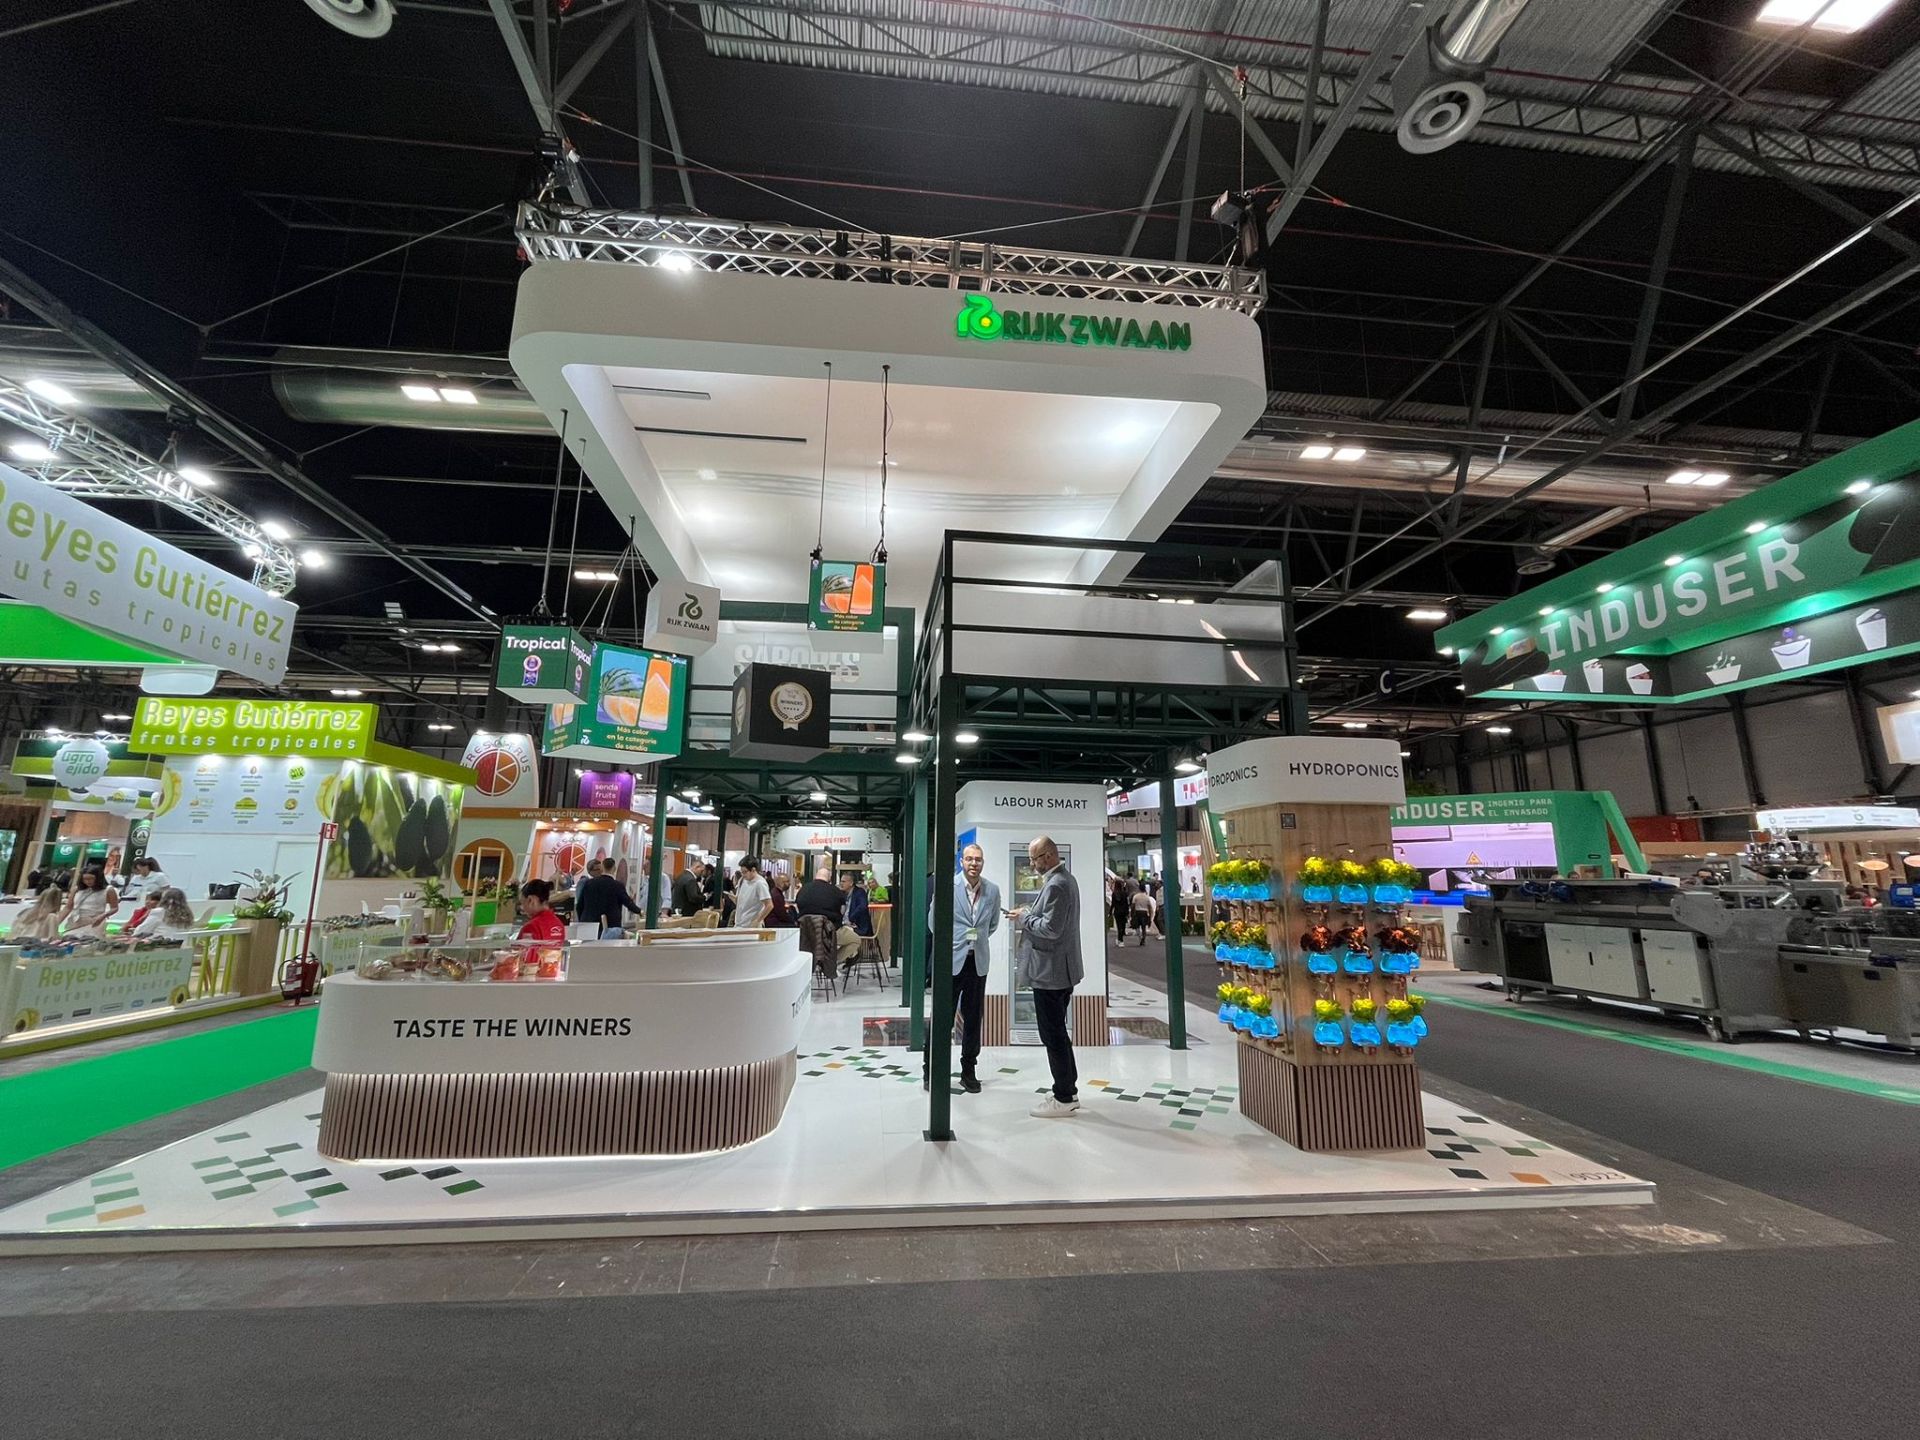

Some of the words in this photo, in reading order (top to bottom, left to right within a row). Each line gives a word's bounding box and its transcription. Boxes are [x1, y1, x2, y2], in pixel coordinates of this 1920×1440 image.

[1002, 310, 1067, 342] RIJK
[1068, 314, 1192, 350] ZWAAN
[134, 546, 285, 643] Gutiérrez
[1540, 537, 1806, 660] INDUSER
[667, 617, 683, 628] RIJK
[683, 620, 710, 632] ZWAAN
[128, 600, 276, 671] tropicales
[505, 636, 567, 651] Tropical
[570, 640, 592, 667] Tropical
[1380, 670, 1392, 694] C
[142, 699, 226, 733] Reyes
[234, 702, 363, 731] Gutiérrez
[139, 731, 217, 746] frutas
[232, 735, 356, 750] tropicales
[66, 763, 100, 776] ejido
[1289, 762, 1400, 778] HYDROPONICS
[594, 783, 618, 791] senda
[594, 791, 617, 799] fruits
[994, 796, 1043, 808] LABOUR
[1047, 798, 1088, 809] SMART
[1390, 801, 1485, 819] NDUSER
[1488, 799, 1526, 807] INGENIO
[1530, 798, 1553, 806] PARA
[1504, 808, 1549, 817] ENVASADO
[38, 966, 98, 990] Reyes
[105, 955, 184, 980] Gutiérrez
[393, 1018, 465, 1038] TASTE
[472, 1018, 518, 1038] THE
[524, 1017, 632, 1037] WINNERS
